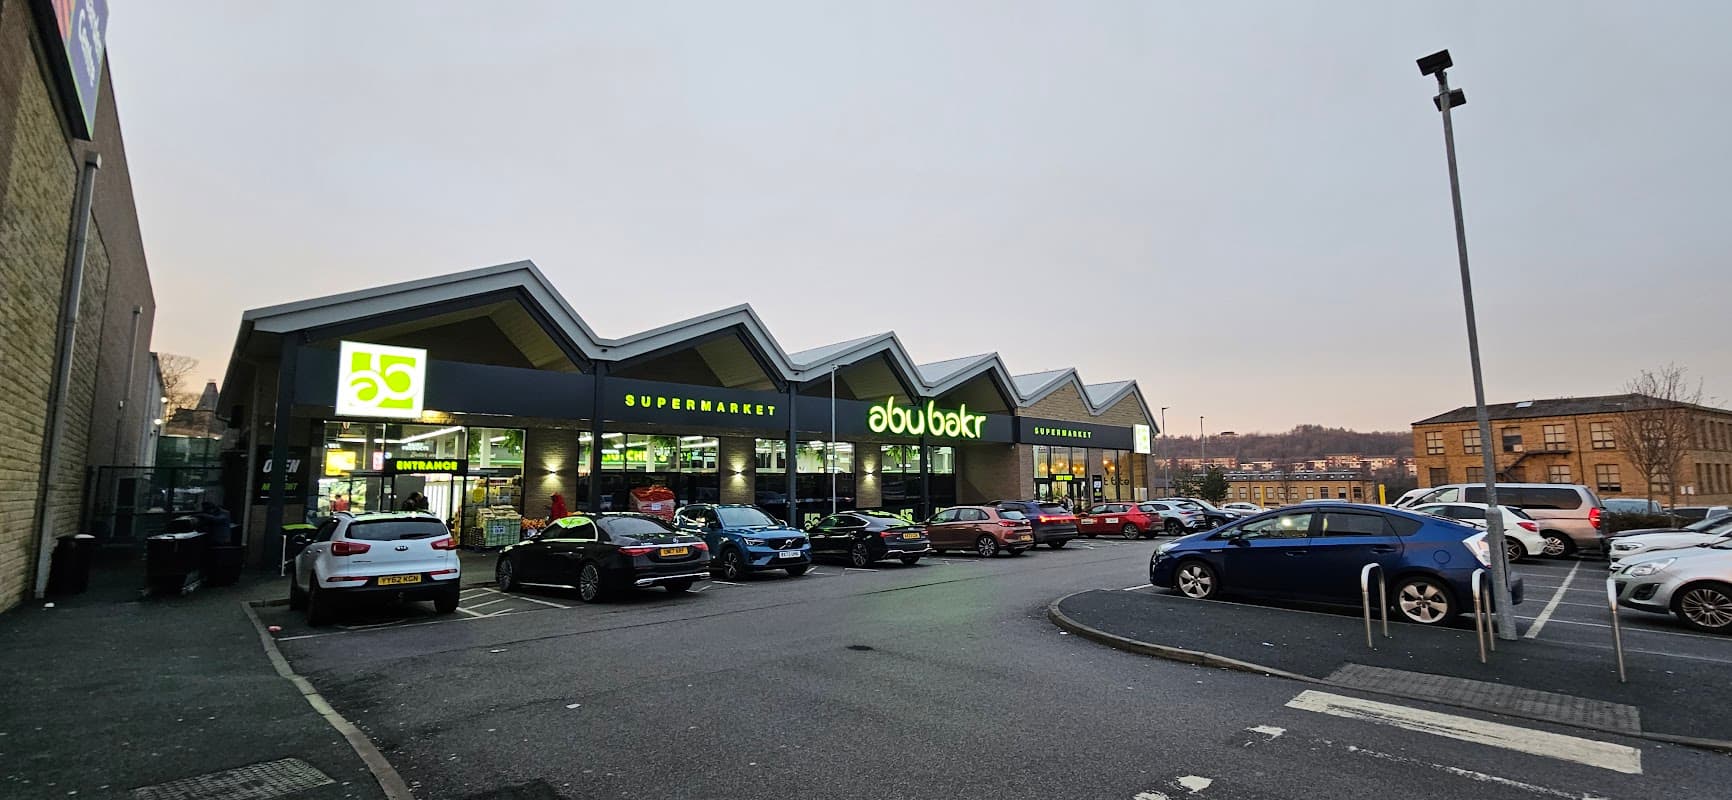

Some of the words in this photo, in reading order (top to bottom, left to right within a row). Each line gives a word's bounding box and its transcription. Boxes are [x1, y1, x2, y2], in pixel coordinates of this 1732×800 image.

[624, 394, 776, 416] SUPERMARKET
[869, 395, 925, 434] abu
[926, 400, 987, 439] bakr
[1033, 426, 1092, 440] SUPERMARKET
[262, 459, 301, 473] OEN
[396, 460, 458, 471] ENTRANCE
